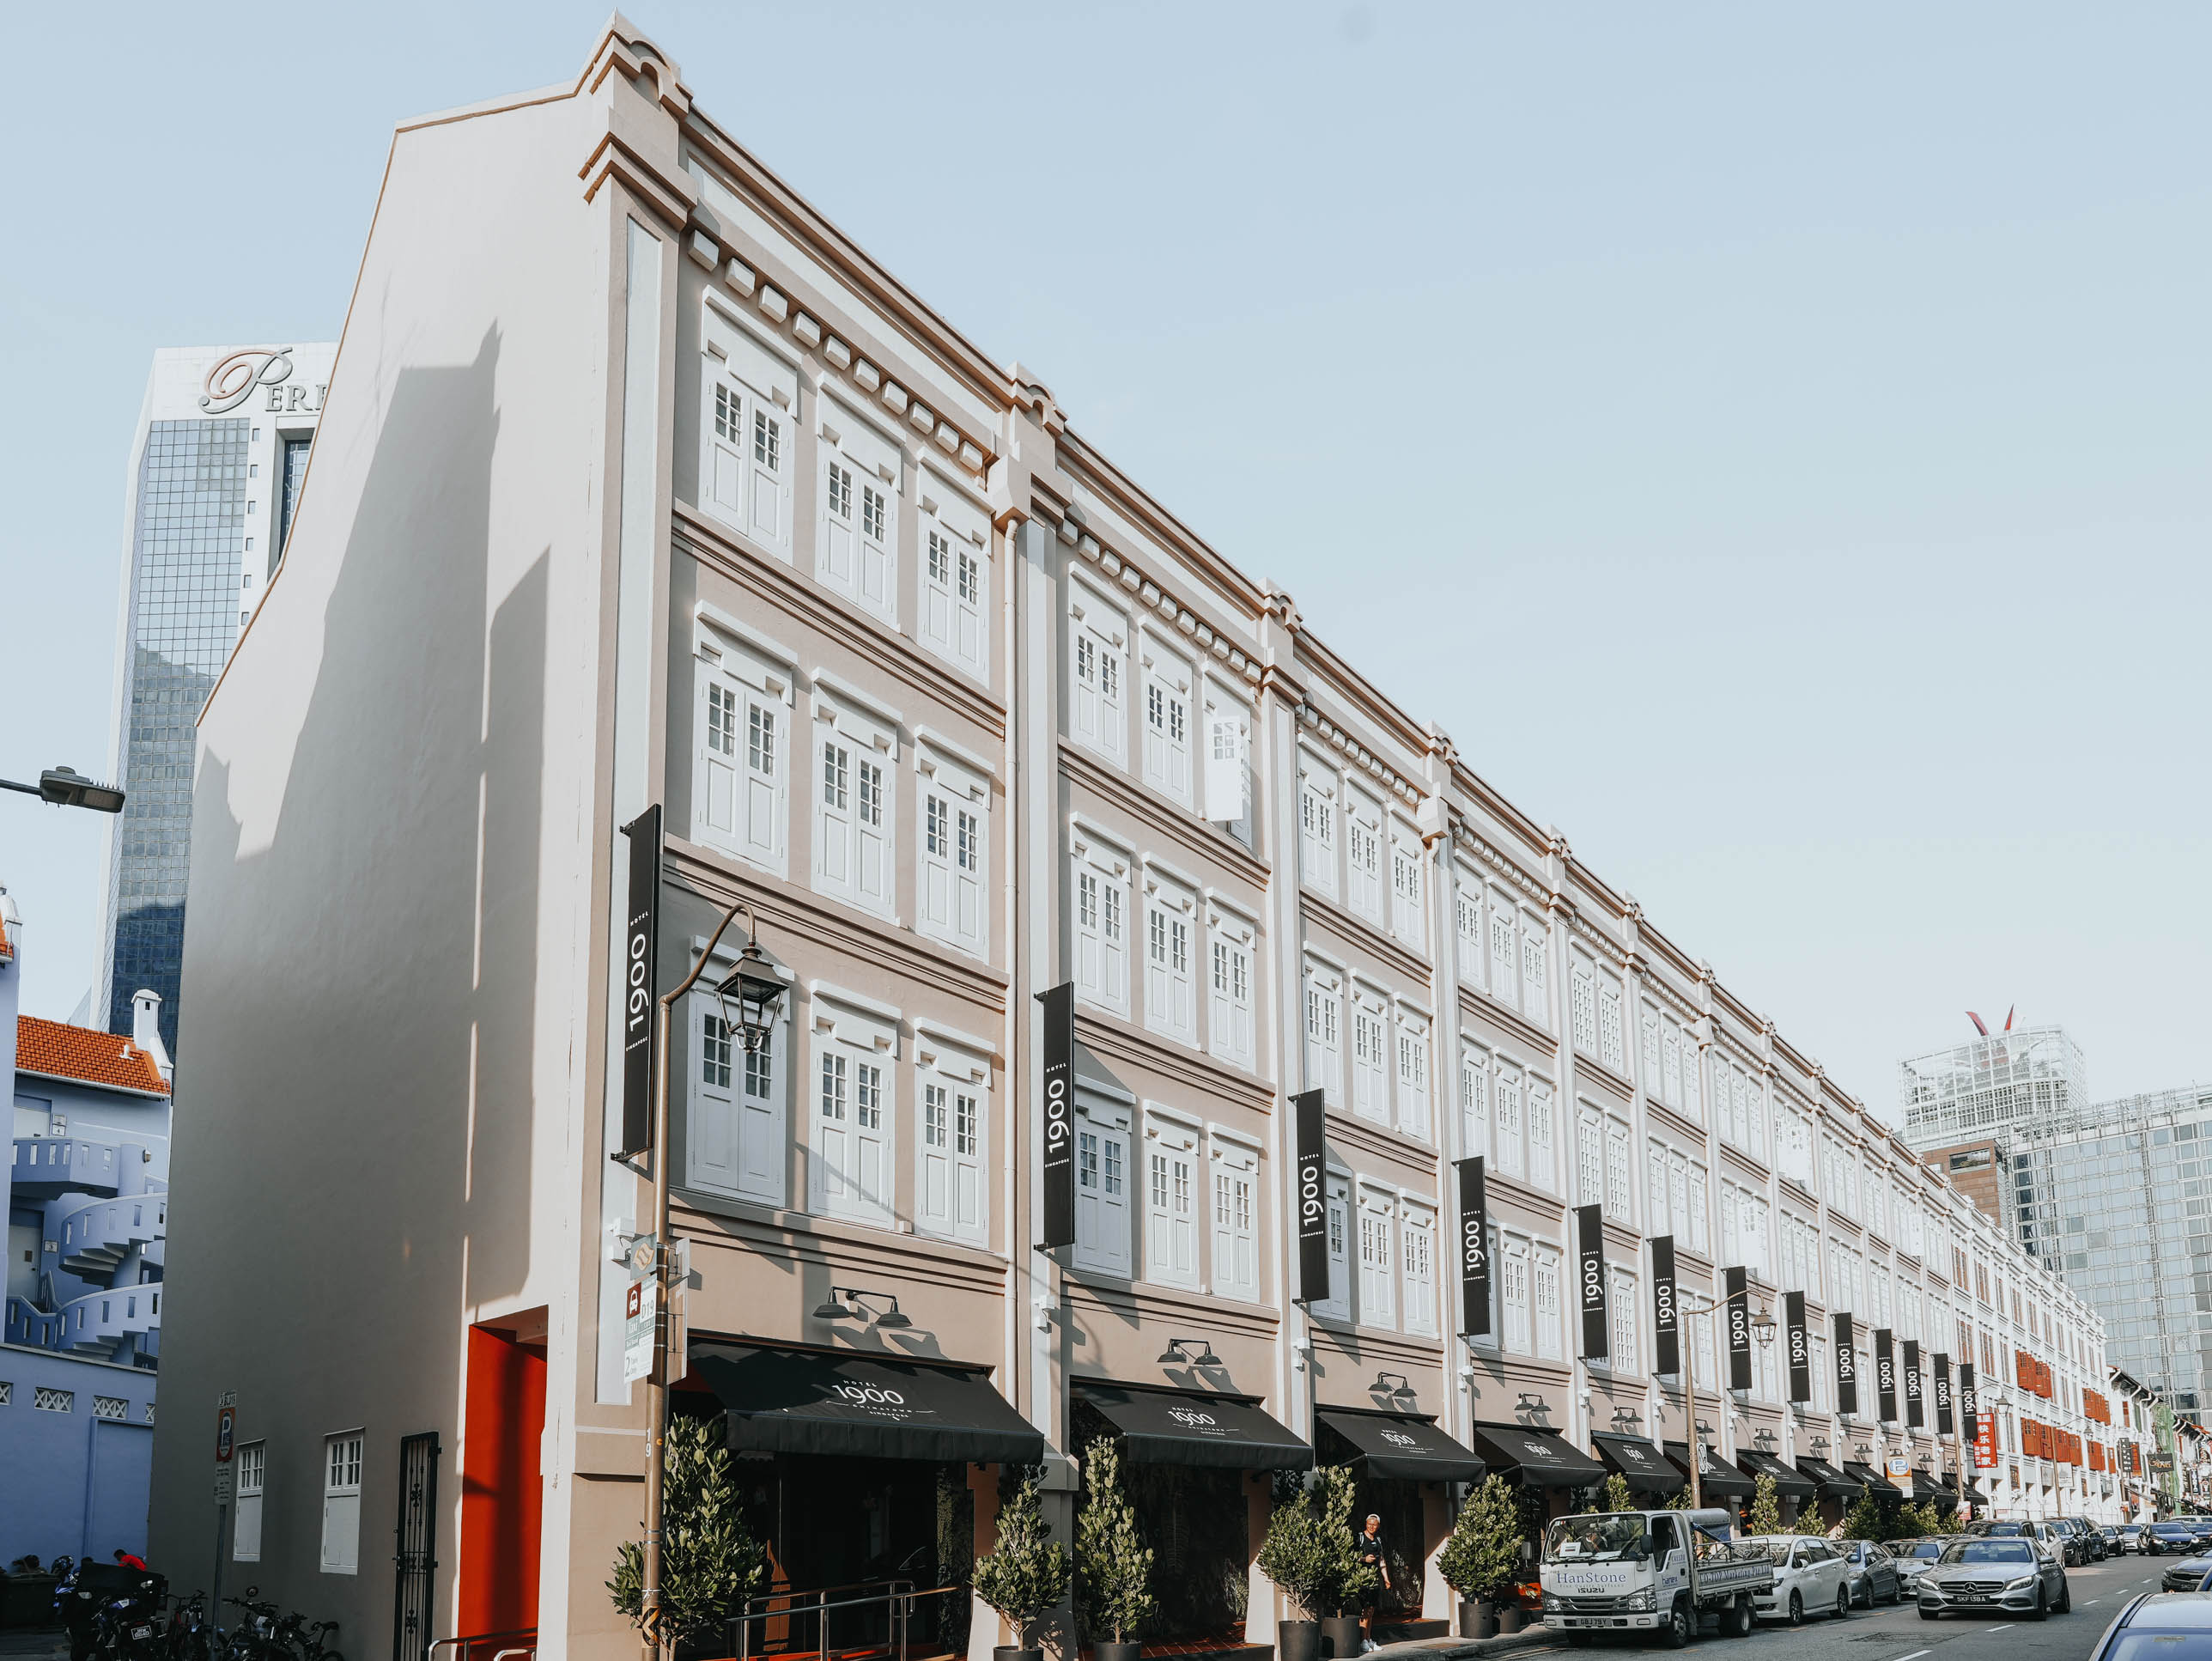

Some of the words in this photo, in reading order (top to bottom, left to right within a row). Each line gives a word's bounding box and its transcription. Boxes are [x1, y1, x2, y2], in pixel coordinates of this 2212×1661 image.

[630, 911, 649, 927] HOTEL
[629, 934, 649, 1031] 1900
[626, 1037, 648, 1052] SINGAPORE
[1047, 1062, 1066, 1073] HOTEL
[1048, 1080, 1070, 1153] 1900
[1045, 1159, 1069, 1168] SINGAPORE
[1303, 1166, 1323, 1226] 1900
[1465, 1220, 1485, 1271] 1900
[1584, 1260, 1603, 1304] 1900
[1658, 1285, 1675, 1325] 1900
[1731, 1311, 1748, 1346] 1900
[1791, 1330, 1807, 1363] 1900
[1839, 1348, 1854, 1378] 1900
[1881, 1362, 1894, 1389] 1900
[831, 1385, 904, 1404] 1900
[1907, 1371, 1920, 1396] 1900
[1938, 1382, 1950, 1406] 1900
[1964, 1390, 1975, 1413] 1900
[1168, 1411, 1216, 1426] 1900
[1381, 1433, 1415, 1445] 1900
[1557, 1573, 1626, 1584] HanStone
